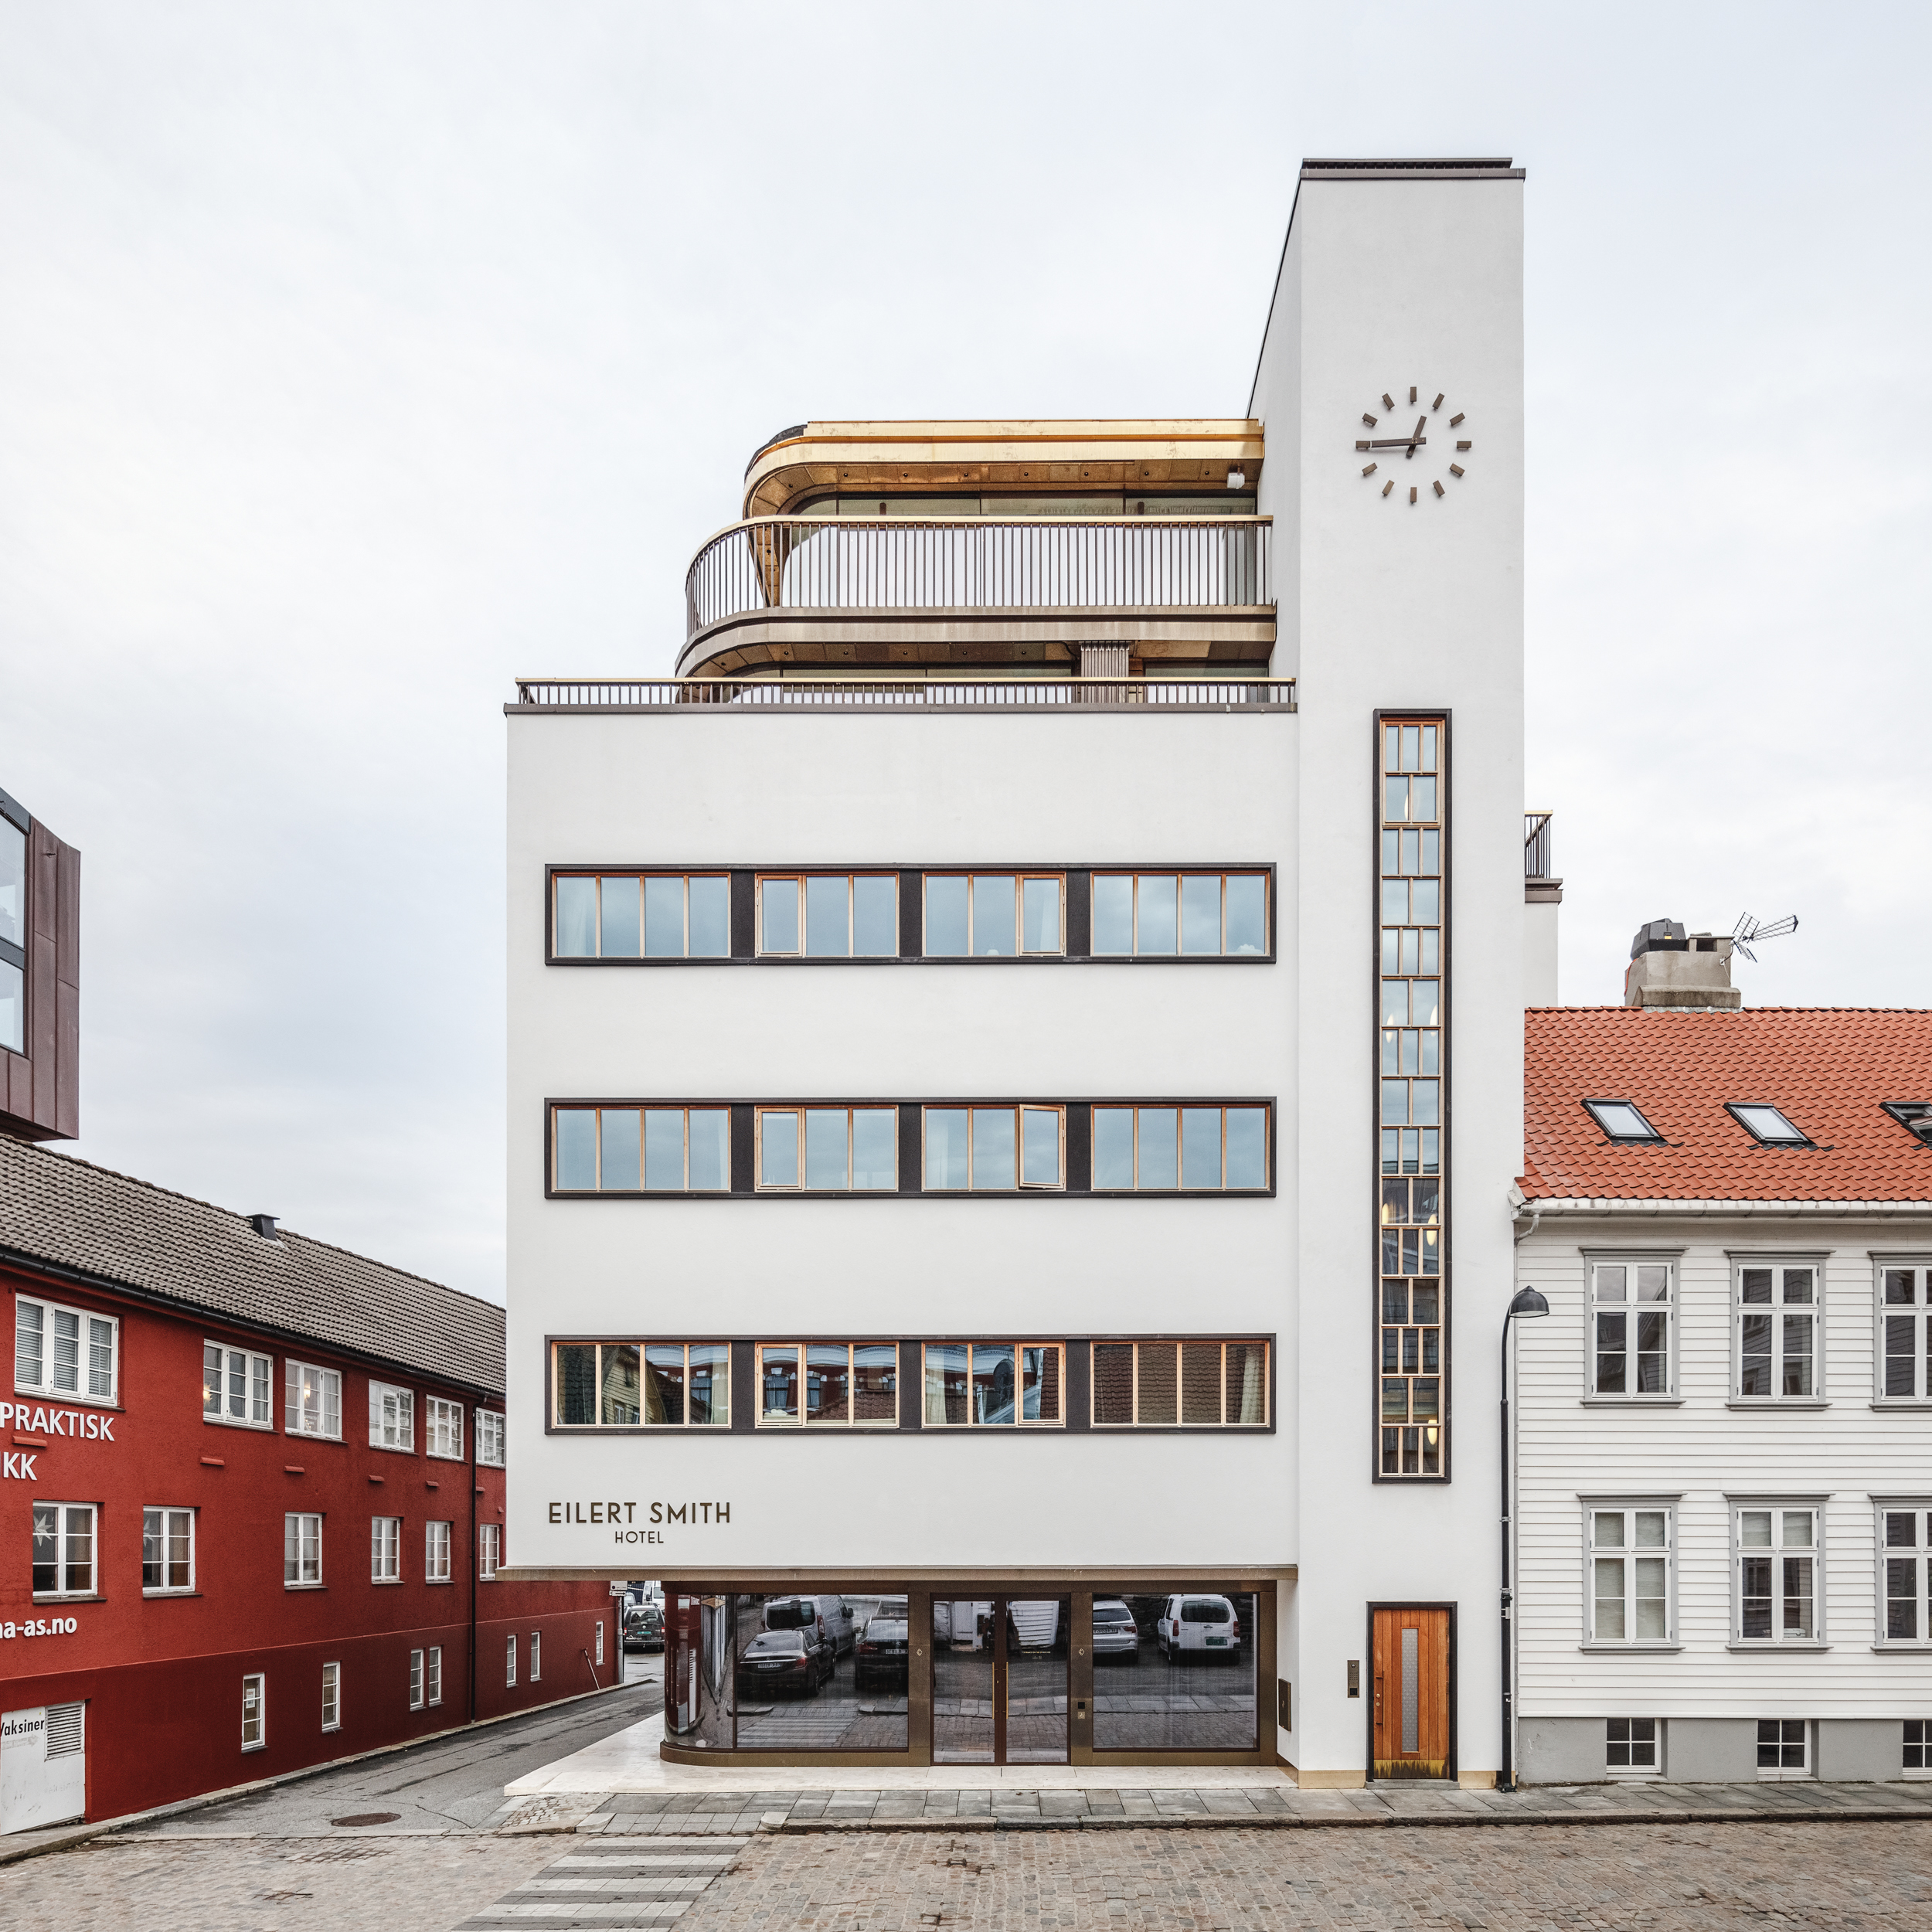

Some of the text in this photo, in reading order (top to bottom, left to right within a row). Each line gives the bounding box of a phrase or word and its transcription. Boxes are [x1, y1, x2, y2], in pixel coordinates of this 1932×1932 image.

[0, 1401, 115, 1441] PRAKTISK
[0, 1451, 38, 1481] KK
[549, 1502, 730, 1525] EILERT SMITH
[615, 1531, 665, 1544] HOTEL
